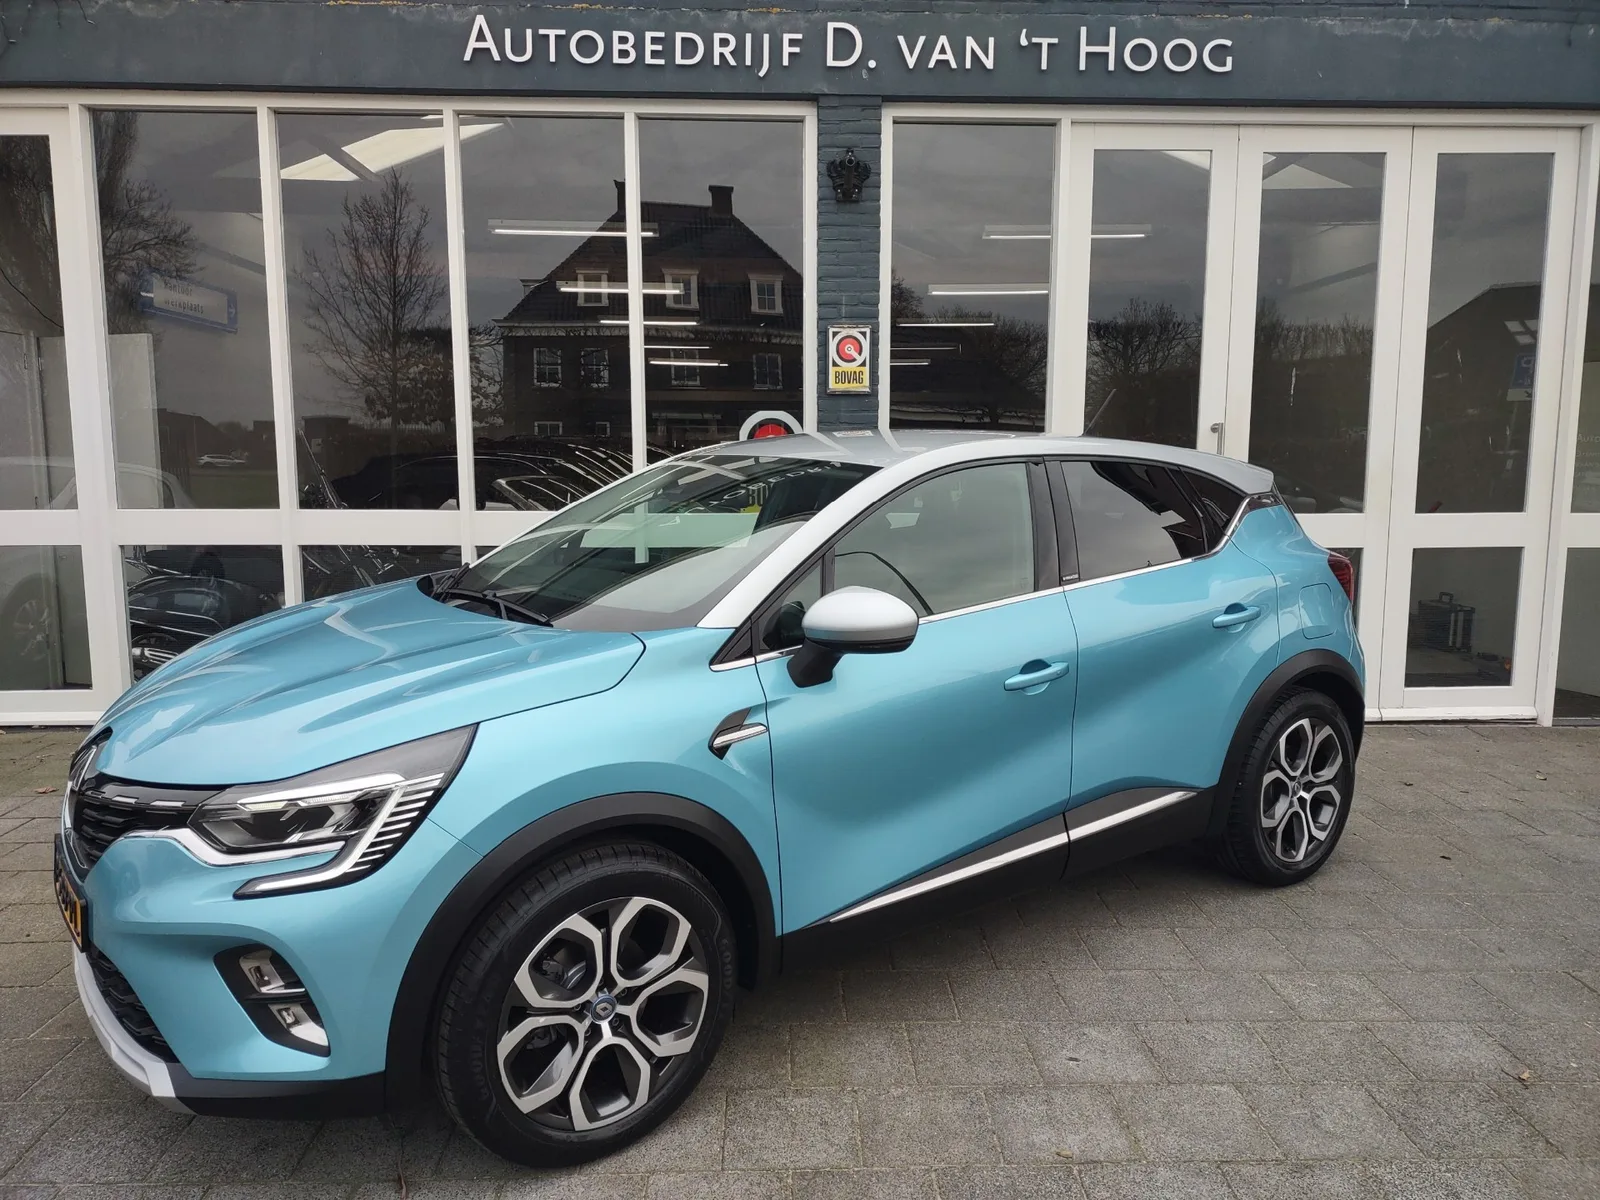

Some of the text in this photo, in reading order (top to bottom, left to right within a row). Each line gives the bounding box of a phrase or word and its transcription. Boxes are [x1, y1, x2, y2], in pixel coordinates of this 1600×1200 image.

[463, 14, 803, 78] AUTOBEDRIJF
[826, 21, 877, 69] D.
[897, 35, 995, 70] VAN
[1079, 25, 1233, 73] HOOG
[834, 370, 864, 385] BOVAG
